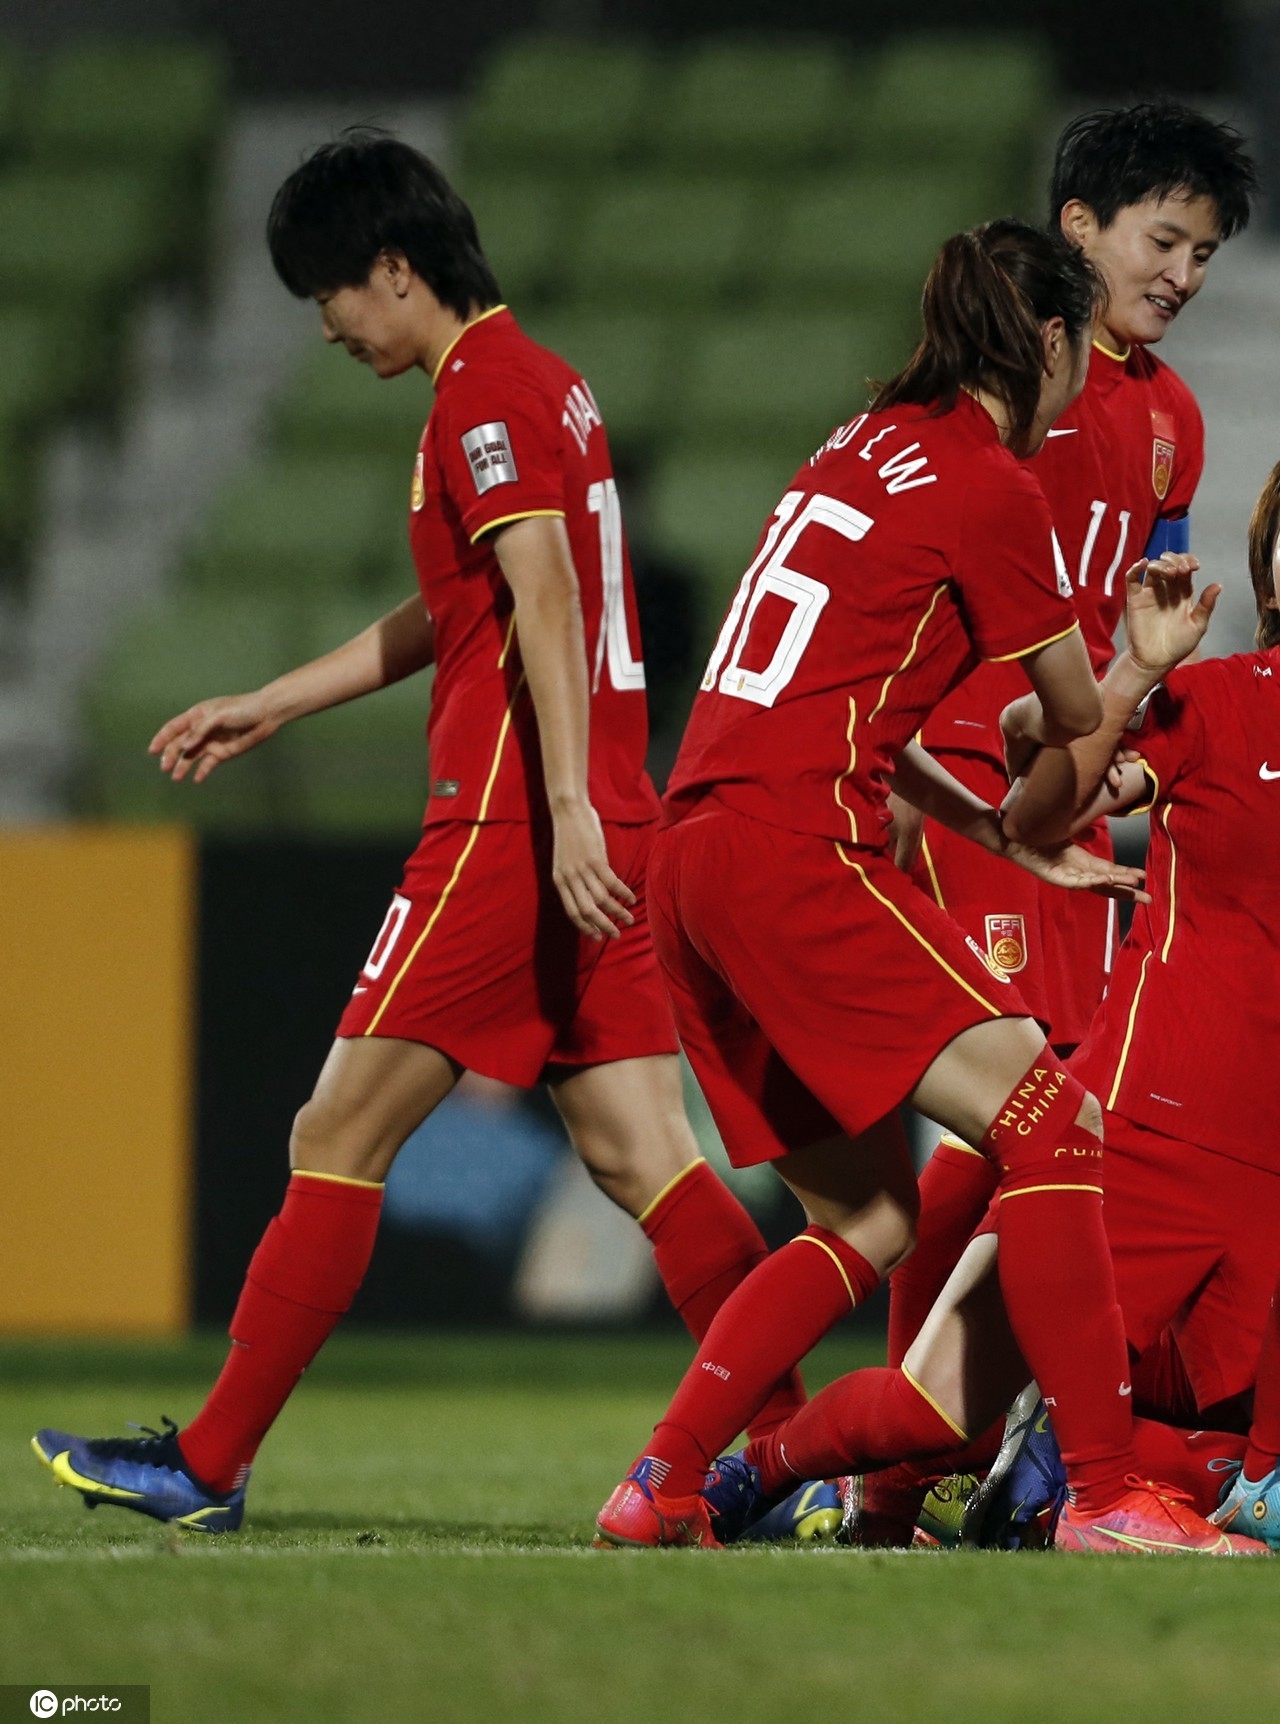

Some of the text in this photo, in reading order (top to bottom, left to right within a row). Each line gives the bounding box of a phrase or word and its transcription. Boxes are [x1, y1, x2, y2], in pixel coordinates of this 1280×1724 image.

[484, 440, 507, 454] GOAL
[490, 453, 507, 465] ALL
[1078, 499, 1132, 597] 11
[700, 490, 875, 709] 16
[990, 919, 1020, 931] CFA
[990, 1068, 1049, 1140] CHINA
[1017, 1071, 1067, 1136] CHINA
[701, 1361, 731, 1381] 中国
